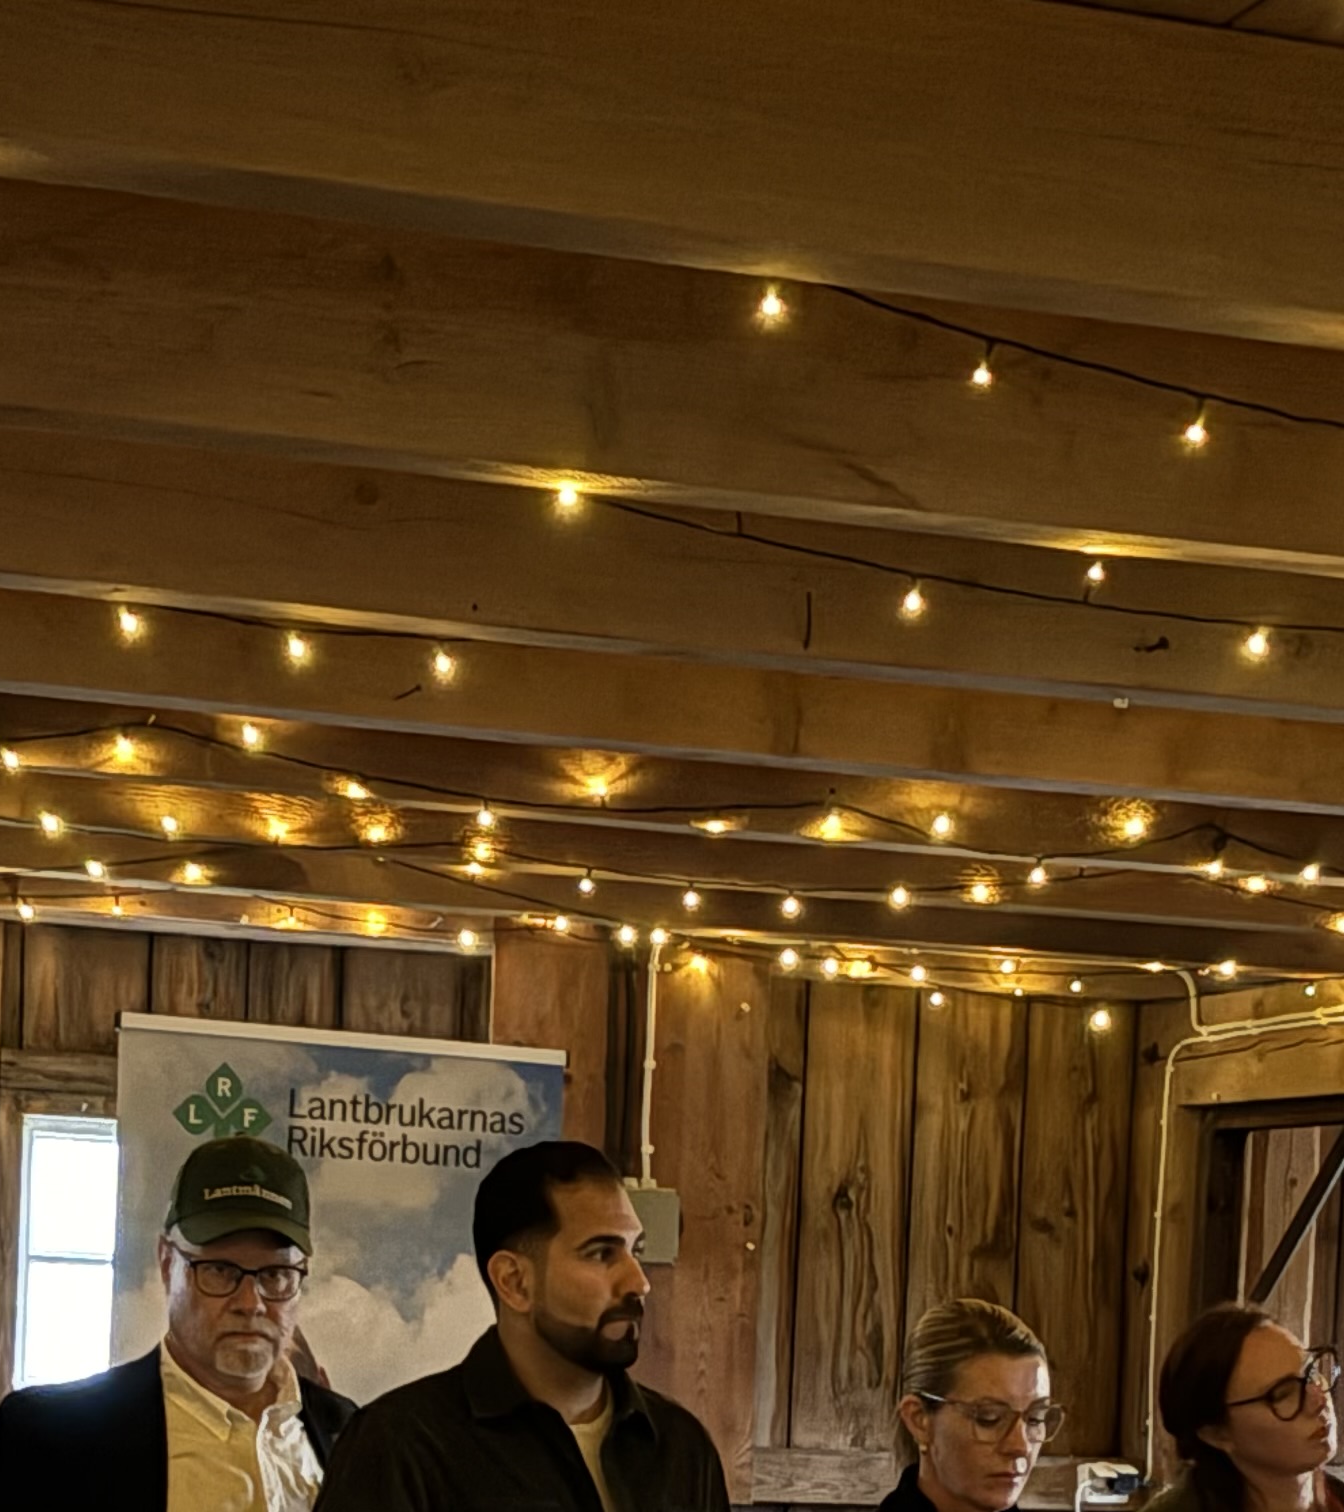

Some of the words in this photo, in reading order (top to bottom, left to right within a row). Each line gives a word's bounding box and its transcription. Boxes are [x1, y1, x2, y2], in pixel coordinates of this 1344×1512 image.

[217, 1077, 232, 1097] R
[188, 1103, 203, 1124] L
[243, 1108, 259, 1128] F
[288, 1088, 525, 1136] Lantbrukarnas
[287, 1125, 482, 1169] Riksförbund
